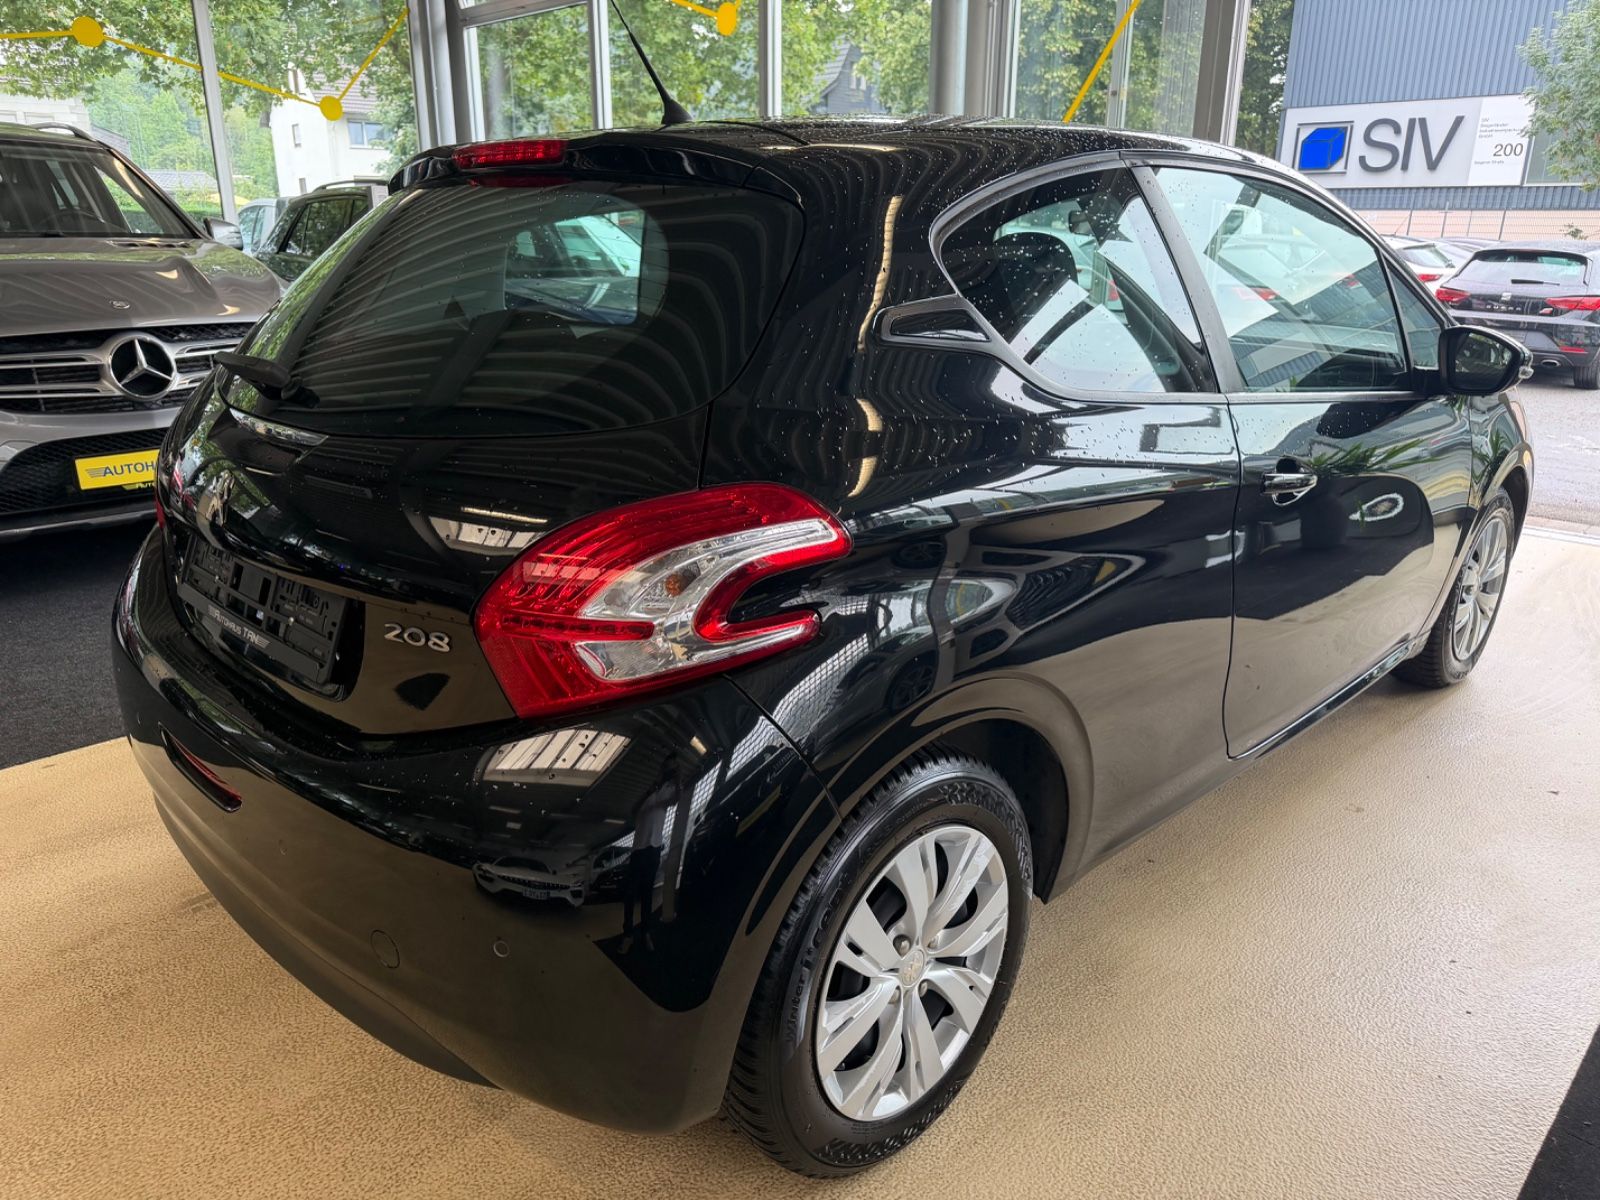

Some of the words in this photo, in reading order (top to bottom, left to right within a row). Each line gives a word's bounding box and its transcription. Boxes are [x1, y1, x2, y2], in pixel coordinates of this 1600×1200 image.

[1358, 115, 1465, 173] SIV
[1493, 143, 1524, 157] 200
[384, 623, 450, 653] 208
